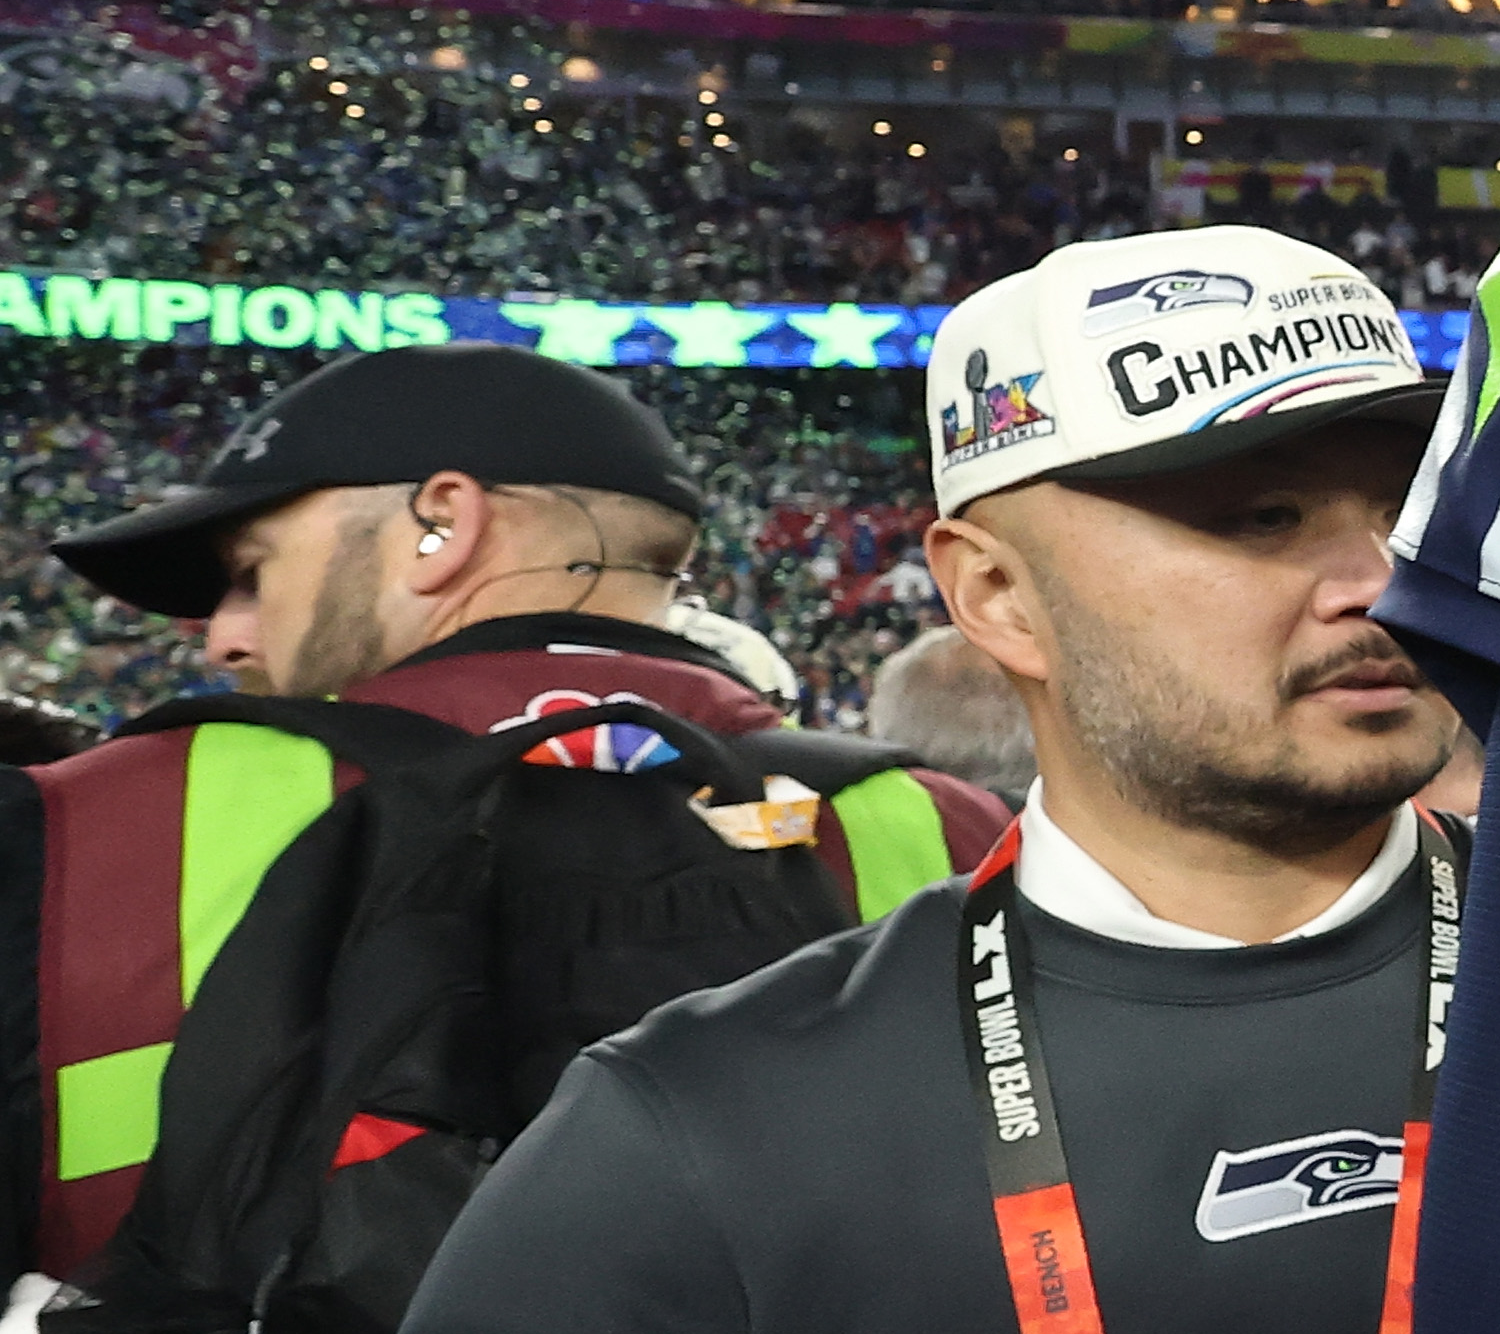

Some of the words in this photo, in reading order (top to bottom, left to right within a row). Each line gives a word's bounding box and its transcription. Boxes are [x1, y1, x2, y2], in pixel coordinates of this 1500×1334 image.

[0, 272, 450, 351] AMPIONS
[1268, 284, 1336, 312] SUPER
[1430, 855, 1459, 921] SUPER
[972, 910, 1013, 1001] LX
[1430, 920, 1461, 980] BOWL
[976, 996, 1025, 1065] BOWL
[988, 1061, 1040, 1143] SUPER
[1032, 1229, 1068, 1313] BENCH
